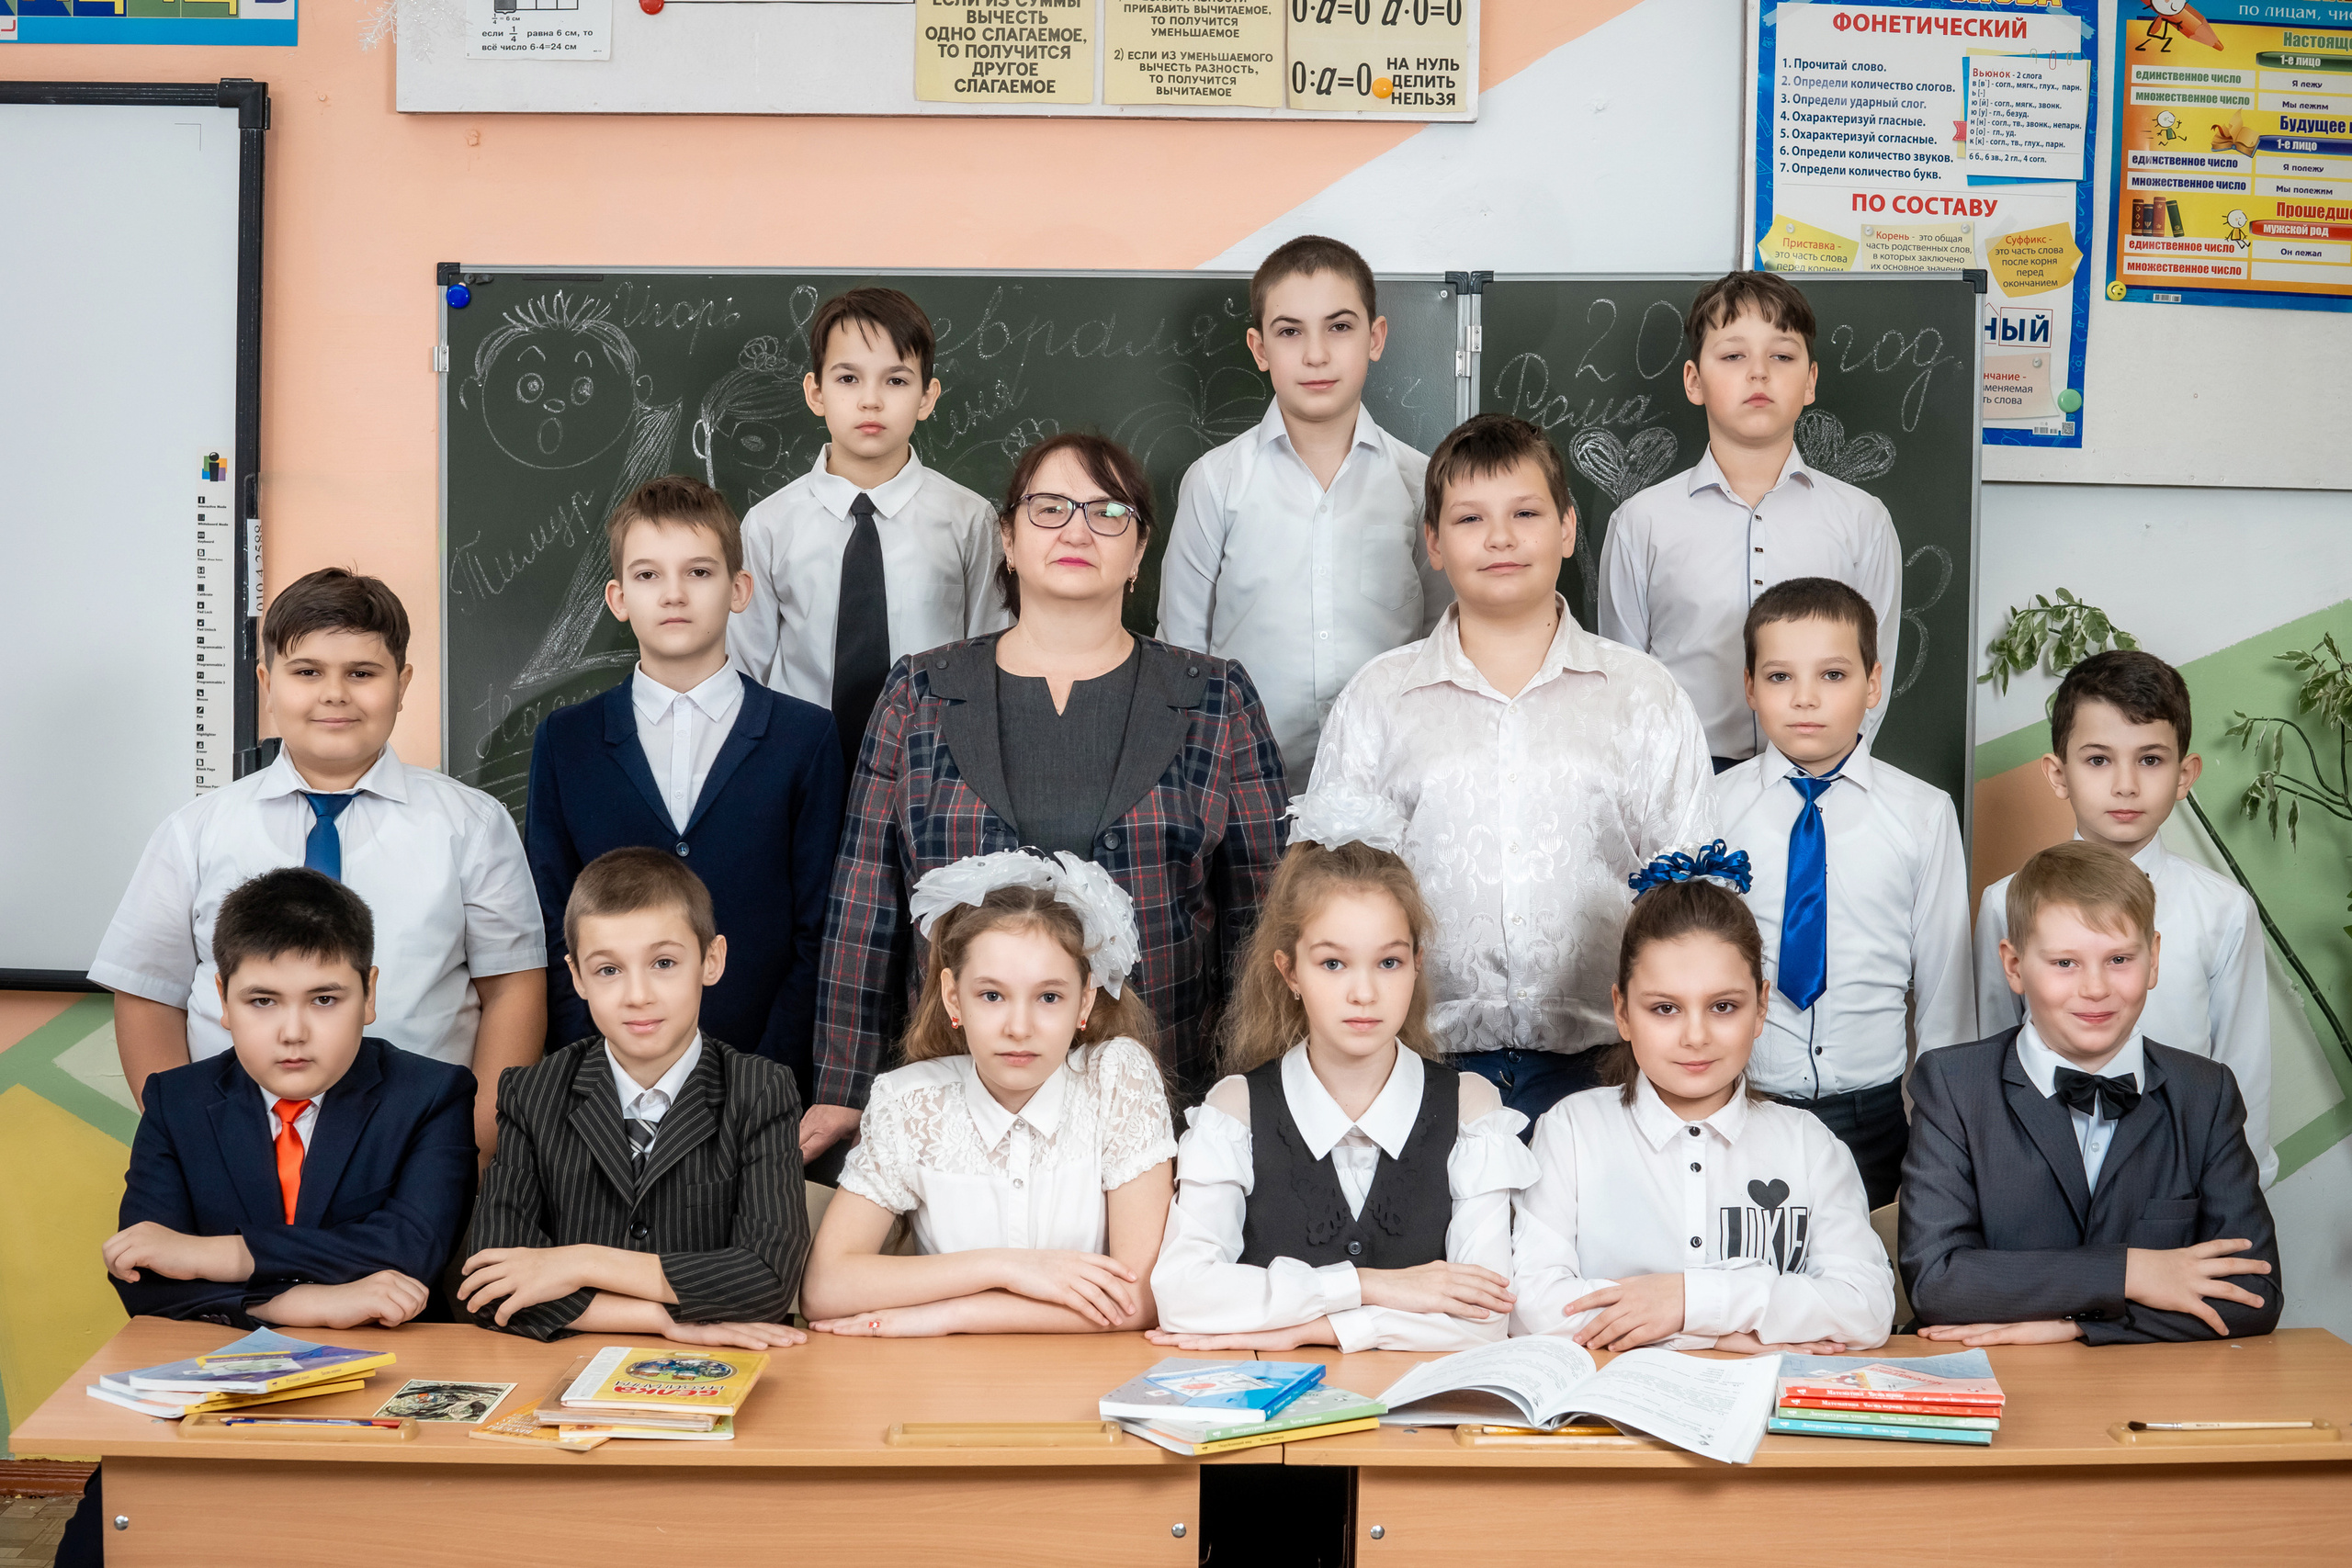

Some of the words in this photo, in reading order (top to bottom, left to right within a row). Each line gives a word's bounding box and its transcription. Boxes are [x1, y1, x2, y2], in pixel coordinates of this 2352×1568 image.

[967, 10, 1048, 24] ВЫЧЕСТЬ
[1124, 5, 1190, 14] ПРИБАВИТЬ
[1194, 6, 1272, 16] ВЫЧИТАЕМОЕ,
[2239, 5, 2259, 17] по
[2265, 6, 2321, 21] лицам,
[1151, 17, 1166, 25] ТО
[1170, 17, 1238, 26] ПОЛУЧИТСЯ
[1833, 12, 2027, 39] ФОНЕТИЧЕСКИЙ
[526, 30, 553, 39] равна
[925, 27, 976, 42] ОДНО
[982, 28, 1087, 44] СЛАГАЕМОЕ,
[1150, 28, 1239, 38] УМЕНЬШАЕМОЕ
[937, 44, 959, 58] ТО
[966, 44, 1070, 59] ПОЛУЧИТСЯ
[1114, 48, 1124, 62] 2)
[1127, 51, 1157, 60] ЕСЛИ
[1161, 51, 1177, 60] ИЗ
[1181, 52, 1273, 62] УМЕНЬШАЕМОГО
[1386, 58, 1409, 70] НА
[1416, 58, 1460, 71] НУЛЬ
[1782, 58, 1792, 68] 1.
[1793, 58, 1848, 72] Прочитай
[1851, 62, 1887, 72] слово.
[2280, 55, 2293, 65] 1-е
[2295, 56, 2321, 68] лицо
[972, 62, 1038, 77] ДРУГОЕ
[1139, 63, 1192, 73] ВЫЧЕСТЬ
[1195, 64, 1259, 76] РАЗНОСТЬ,
[1973, 68, 2010, 78] Вьюнок
[1149, 74, 1163, 84] ТО
[1168, 75, 1237, 85] ПОЛУЧИТСЯ
[1393, 74, 1456, 89] ДЕЛИТЬ
[2135, 69, 2209, 83] единственное
[2211, 73, 2242, 84] число
[955, 79, 1056, 94] СЛАГАЕМОЕ
[1156, 86, 1232, 96] ВЫЧИТАЕМОЕ
[1781, 76, 1791, 86] 2.
[1793, 76, 1848, 90] Определи
[1850, 81, 1913, 92] количество
[1916, 84, 1955, 93] слогов.
[2063, 85, 2082, 93] парн.
[2301, 82, 2323, 90] лежу
[1391, 93, 1456, 106] НЕЛЬЗЯ
[1781, 94, 1790, 104] 3.
[1792, 94, 1848, 107] Определи
[1849, 97, 1898, 109] ударный
[1901, 99, 1927, 109] слог.
[2135, 90, 2218, 104] множественное
[2220, 95, 2250, 106] число
[2282, 100, 2297, 109] Мы
[2300, 102, 2329, 110] лежим
[1780, 111, 1790, 121] 4.
[1792, 111, 1875, 127] Охарактеризуй
[1878, 117, 1926, 127] гласные.
[2279, 116, 2346, 135] Будущее
[1780, 129, 1789, 139] 5.
[1792, 129, 1875, 144] Охарактеризуй
[1878, 134, 1938, 145] согласные.
[2277, 140, 2290, 150] 1-е
[2292, 141, 2318, 152] лицо
[1780, 146, 1789, 156] 6.
[1792, 146, 1847, 159] Определи
[1849, 152, 1910, 163] количество
[1914, 154, 1953, 165] звуков.
[2132, 154, 2205, 168] единственное
[2208, 158, 2238, 169] число
[1780, 163, 1790, 173] 7.
[1792, 163, 1847, 176] Определи
[1849, 168, 1910, 180] количество
[1914, 169, 1941, 181] букв.
[2291, 164, 2324, 173] полежу
[2132, 176, 2214, 190] множественное
[2216, 180, 2246, 191] число
[2276, 185, 2290, 193] Мы
[2293, 186, 2333, 195] полежим
[1852, 194, 1885, 212] ПО
[1893, 196, 1998, 218] СОСТАВУ
[1876, 231, 1910, 243] Корень
[2263, 223, 2308, 237] мужской
[2310, 226, 2329, 239] род
[1782, 238, 1836, 251] Приставка
[1935, 234, 1963, 244] общая
[2005, 235, 2047, 247] Суффикс
[1866, 243, 1889, 251] часть
[1892, 243, 1949, 254] родственных
[1951, 246, 1973, 254] слов,
[1995, 248, 2009, 256] это
[2012, 247, 2036, 255] часть
[2038, 246, 2064, 254] слова
[2129, 239, 2202, 253] единственное
[2204, 243, 2235, 254] число
[2280, 248, 2292, 256] Он
[2295, 249, 2323, 257] лежал
[1775, 251, 1790, 259] это
[1792, 253, 1818, 262] часть
[1820, 254, 1848, 264] слова
[1880, 254, 1917, 263] которых
[1918, 255, 1965, 264] заключено
[2030, 257, 2058, 267] корня
[2016, 269, 2043, 278] перед
[2127, 261, 2209, 275] множественное
[2211, 265, 2242, 276] число
[2003, 279, 2058, 288] окончанием
[1994, 396, 2022, 405] слова
[449, 490, 594, 606] Тимур
